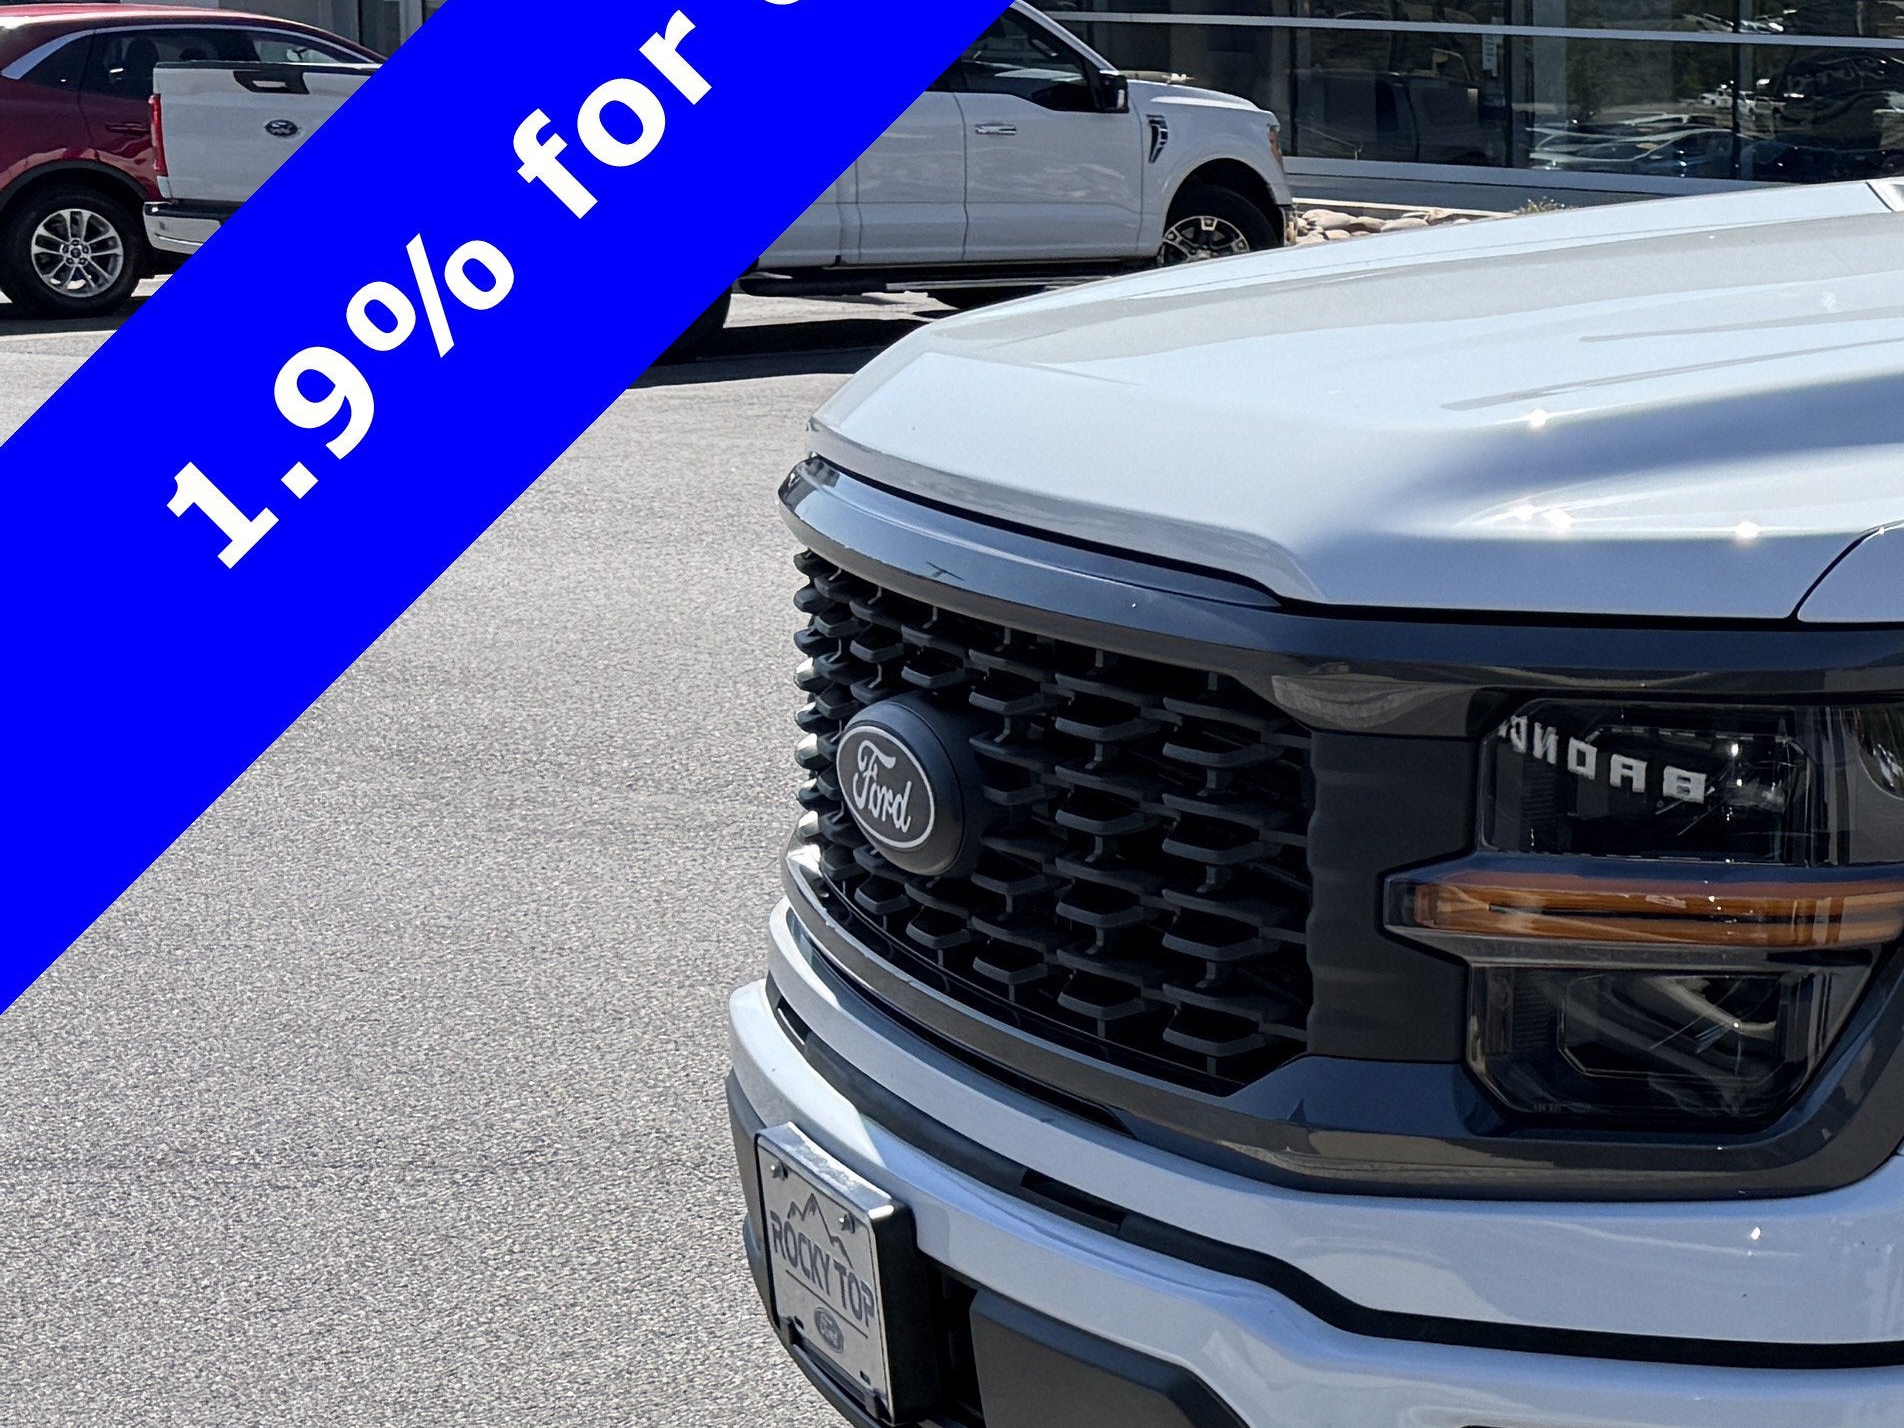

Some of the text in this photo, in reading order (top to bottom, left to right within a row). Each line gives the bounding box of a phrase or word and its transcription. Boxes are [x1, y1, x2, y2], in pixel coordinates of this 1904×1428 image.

[853, 740, 912, 833] Ford
[770, 1210, 875, 1328] ROCKY TOP
